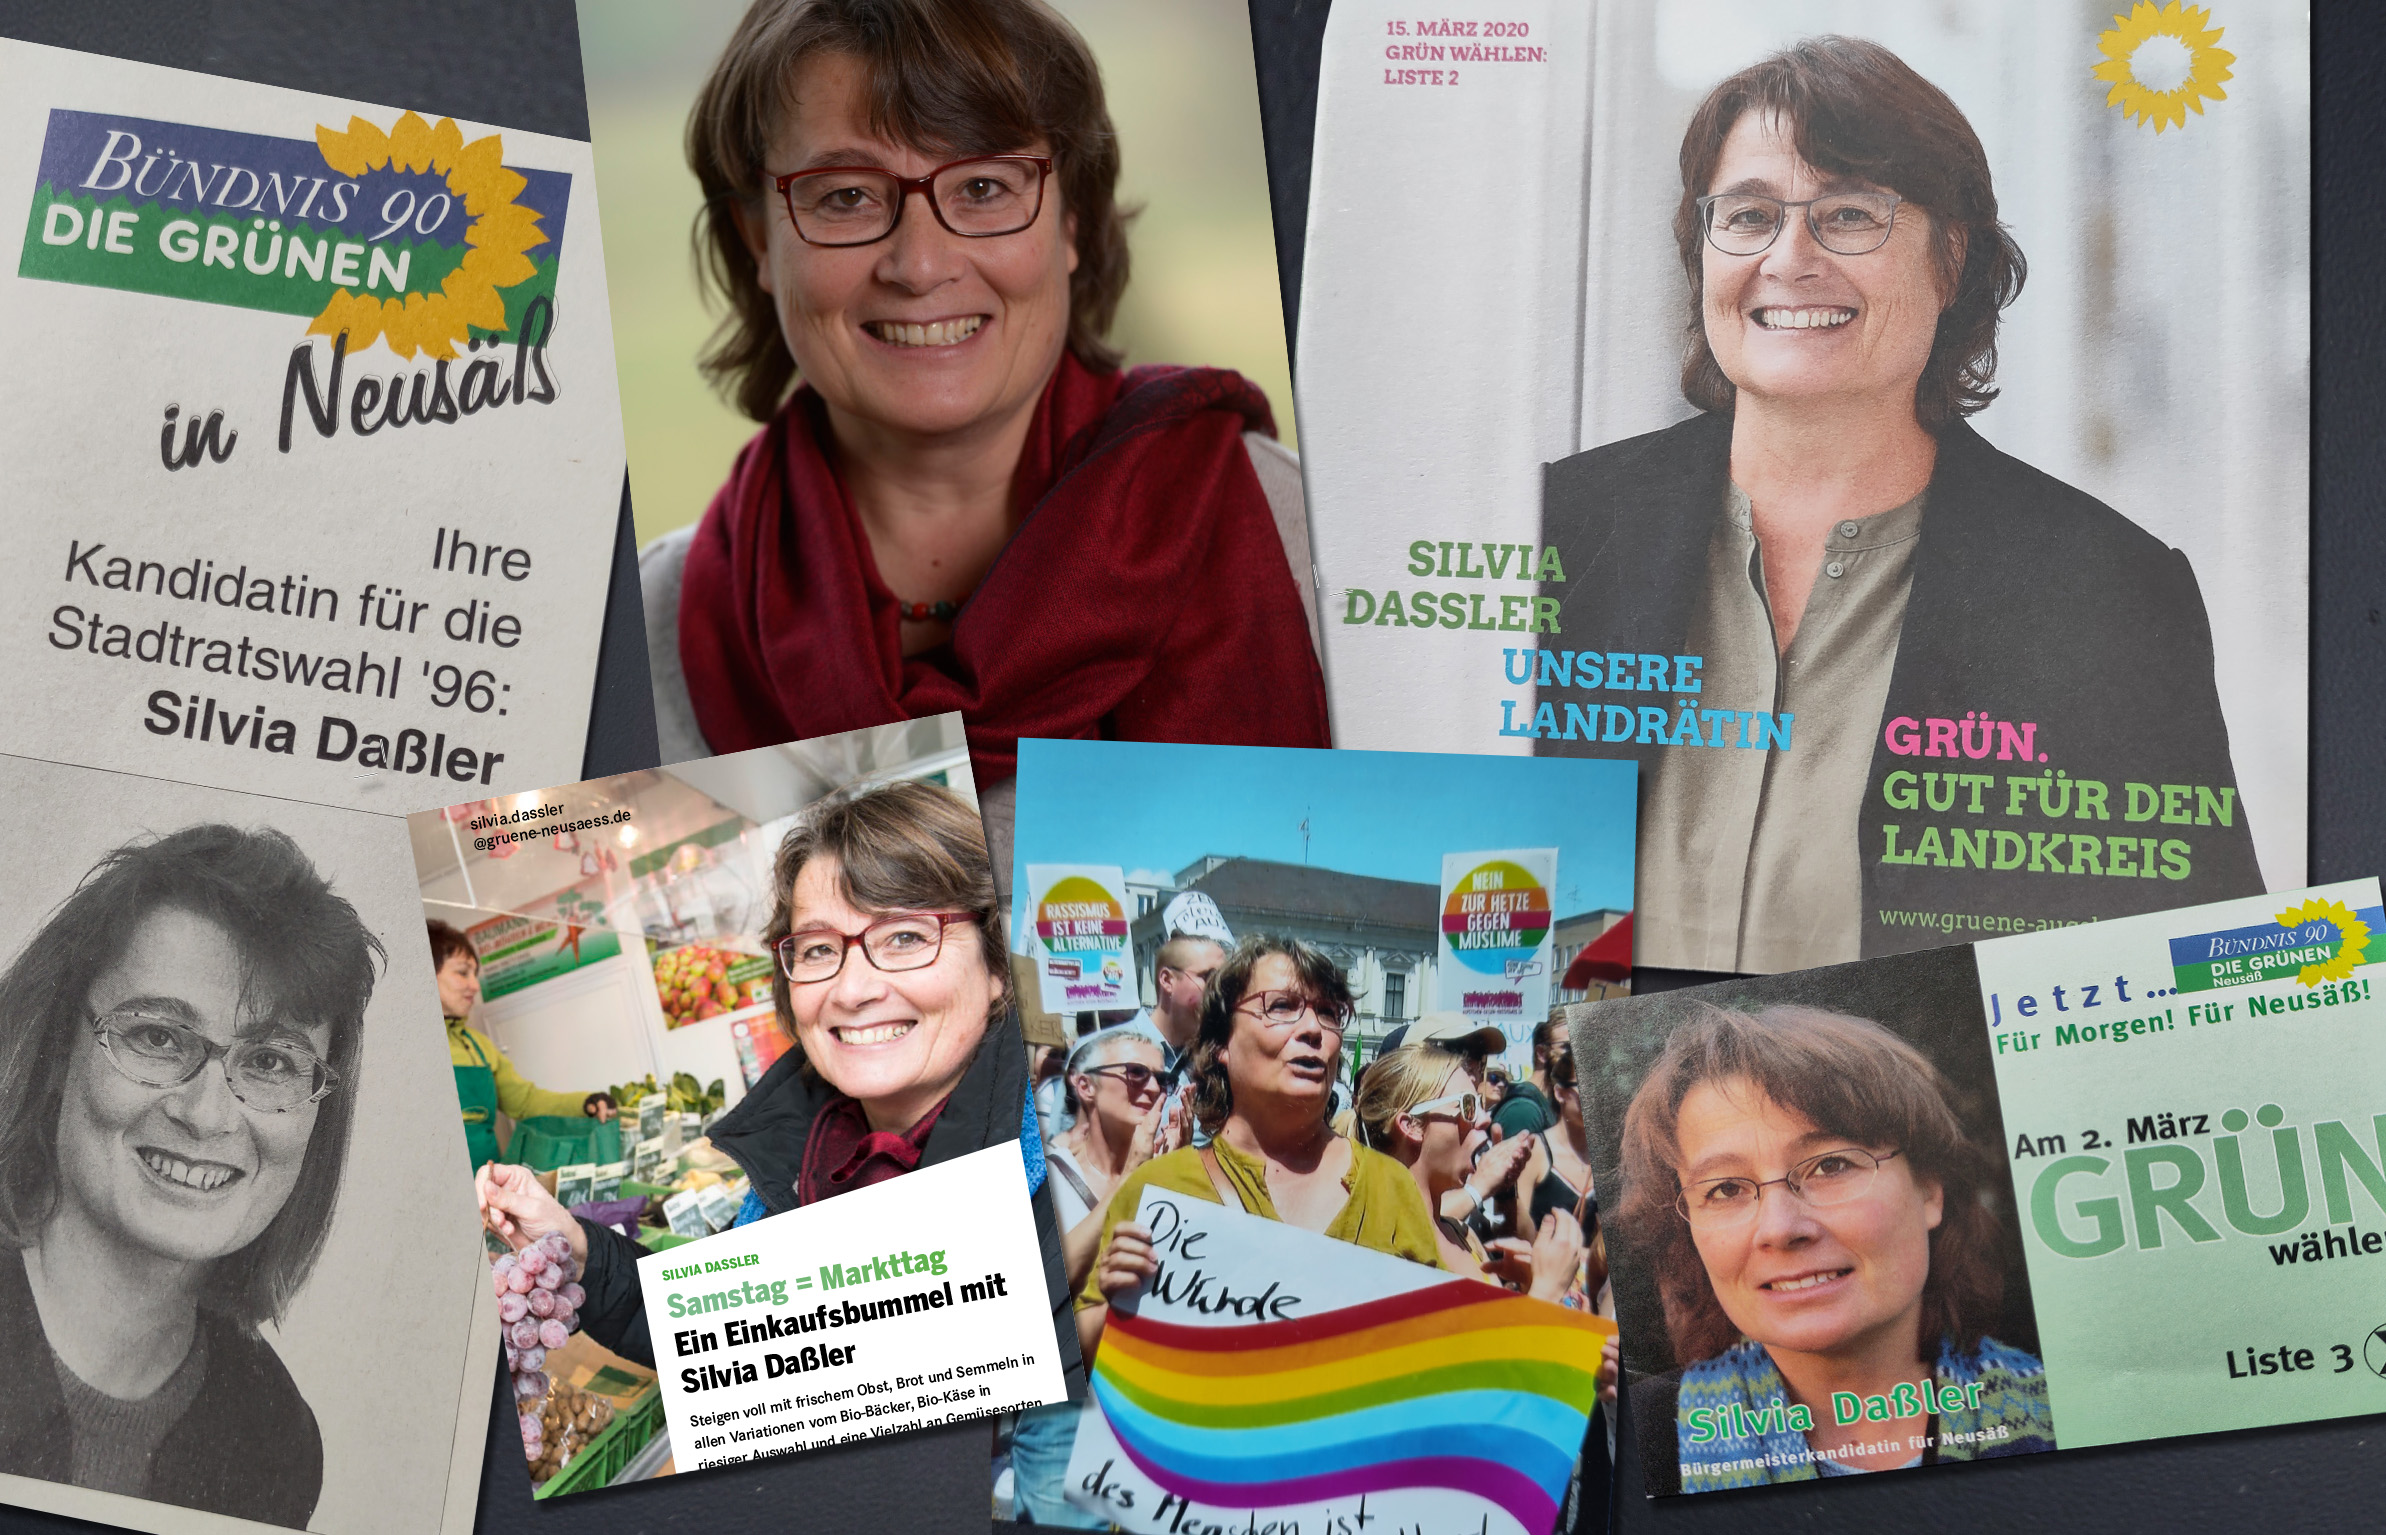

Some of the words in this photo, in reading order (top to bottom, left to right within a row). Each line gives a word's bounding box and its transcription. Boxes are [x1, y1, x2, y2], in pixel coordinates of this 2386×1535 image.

[1387, 21, 1410, 36] 15.
[1416, 18, 1478, 37] MÄRZ
[1483, 22, 1529, 37] 2020
[1385, 42, 1446, 61] GRÜN
[1449, 43, 1548, 62] WÄHLEN:
[1384, 69, 1444, 85] LISTE
[1449, 70, 1459, 86] 2
[80, 129, 360, 223] BÜNDNIS
[367, 189, 451, 241] 90
[42, 205, 139, 254] DIE
[159, 220, 411, 292] GRÜNEN
[160, 402, 238, 471] in
[278, 294, 560, 454] Neusäß
[432, 527, 532, 582] Ihre
[1407, 540, 1567, 582] SILVIA
[65, 540, 339, 622] Kandidatin
[360, 584, 429, 634] für
[444, 600, 523, 649] die
[1343, 588, 1562, 634] DASSLER
[48, 605, 402, 700] Stadtratswahl
[422, 661, 513, 716] '96:
[1502, 648, 1703, 693] UNSERE
[143, 690, 296, 755] Silvia
[316, 716, 505, 785] Daßler
[1499, 699, 1796, 752] LANDRÄTIN
[1884, 711, 2049, 763] GRÜN.
[470, 802, 564, 831] silvia.dassler
[1883, 770, 1994, 814] GUT
[2005, 769, 2110, 821] FÜR
[2123, 782, 2236, 827] DEN
[473, 809, 631, 852] @gruene-neusaess.de
[1881, 824, 2192, 881] LANDKREIS
[1461, 894, 1485, 912] ZUR
[1491, 892, 1529, 911] HETZE
[1472, 870, 1504, 891] NEIN
[1046, 903, 1110, 919] RASSISMUS
[1053, 921, 1070, 936] IST
[1075, 920, 1104, 935] KEINE
[1467, 912, 1510, 931] GEGEN
[1054, 935, 1122, 952] ALTERNATIVE
[1458, 929, 1521, 950] MUSLIME
[2208, 930, 2296, 959] BÜNDNIS
[2304, 924, 2327, 943] 90
[2211, 958, 2243, 977] DIE
[2248, 945, 2331, 969] GRÜNEN
[2213, 970, 2263, 987] Neusäß
[1996, 1031, 2041, 1054] Für
[2055, 1009, 2174, 1046] Morgen!
[2189, 1001, 2235, 1027] Für
[2248, 979, 2371, 1017] Neusäß!
[2014, 1133, 2066, 1159] Am
[2081, 1130, 2112, 1149] 2.
[2126, 1112, 2210, 1143] März
[2030, 1103, 2386, 1259] GRÜN
[1146, 1200, 1208, 1260] Die
[2268, 1226, 2386, 1265] wähle
[662, 1262, 702, 1281] SILVIA
[705, 1253, 760, 1274] DASSLER
[666, 1276, 788, 1319] Samstag
[819, 1247, 947, 1293] Markttag
[674, 1329, 718, 1357] Ein
[724, 1279, 954, 1348] Einkaufsbummel
[959, 1272, 1008, 1303] mit
[680, 1358, 759, 1394] Silvia
[764, 1342, 856, 1380] Daßler
[2227, 1345, 2315, 1379] Liste
[2330, 1344, 2354, 1373] 3
[690, 1411, 740, 1427] Steigen
[743, 1403, 766, 1418] voll
[770, 1398, 792, 1413] mit
[796, 1388, 854, 1408] frischem
[857, 1380, 893, 1396] Obst,
[896, 1374, 924, 1389] Brot
[928, 1368, 953, 1383] und
[956, 1357, 1019, 1378] Semmeln
[1022, 1354, 1035, 1366] in
[1689, 1399, 1815, 1444] Silvia
[1831, 1379, 1985, 1426] Daßler
[694, 1435, 726, 1449] allen
[729, 1420, 805, 1443] Variationen
[809, 1414, 837, 1429] vom
[840, 1400, 915, 1423] Bio-Bäcker,
[917, 1388, 975, 1408] Bio-Käse
[979, 1385, 991, 1397] in
[1680, 1440, 1900, 1477] Bürgermeisterkandidatin
[1909, 1434, 1934, 1450] für
[1942, 1425, 2009, 1446] Neusäß
[1082, 1459, 1135, 1508] des
